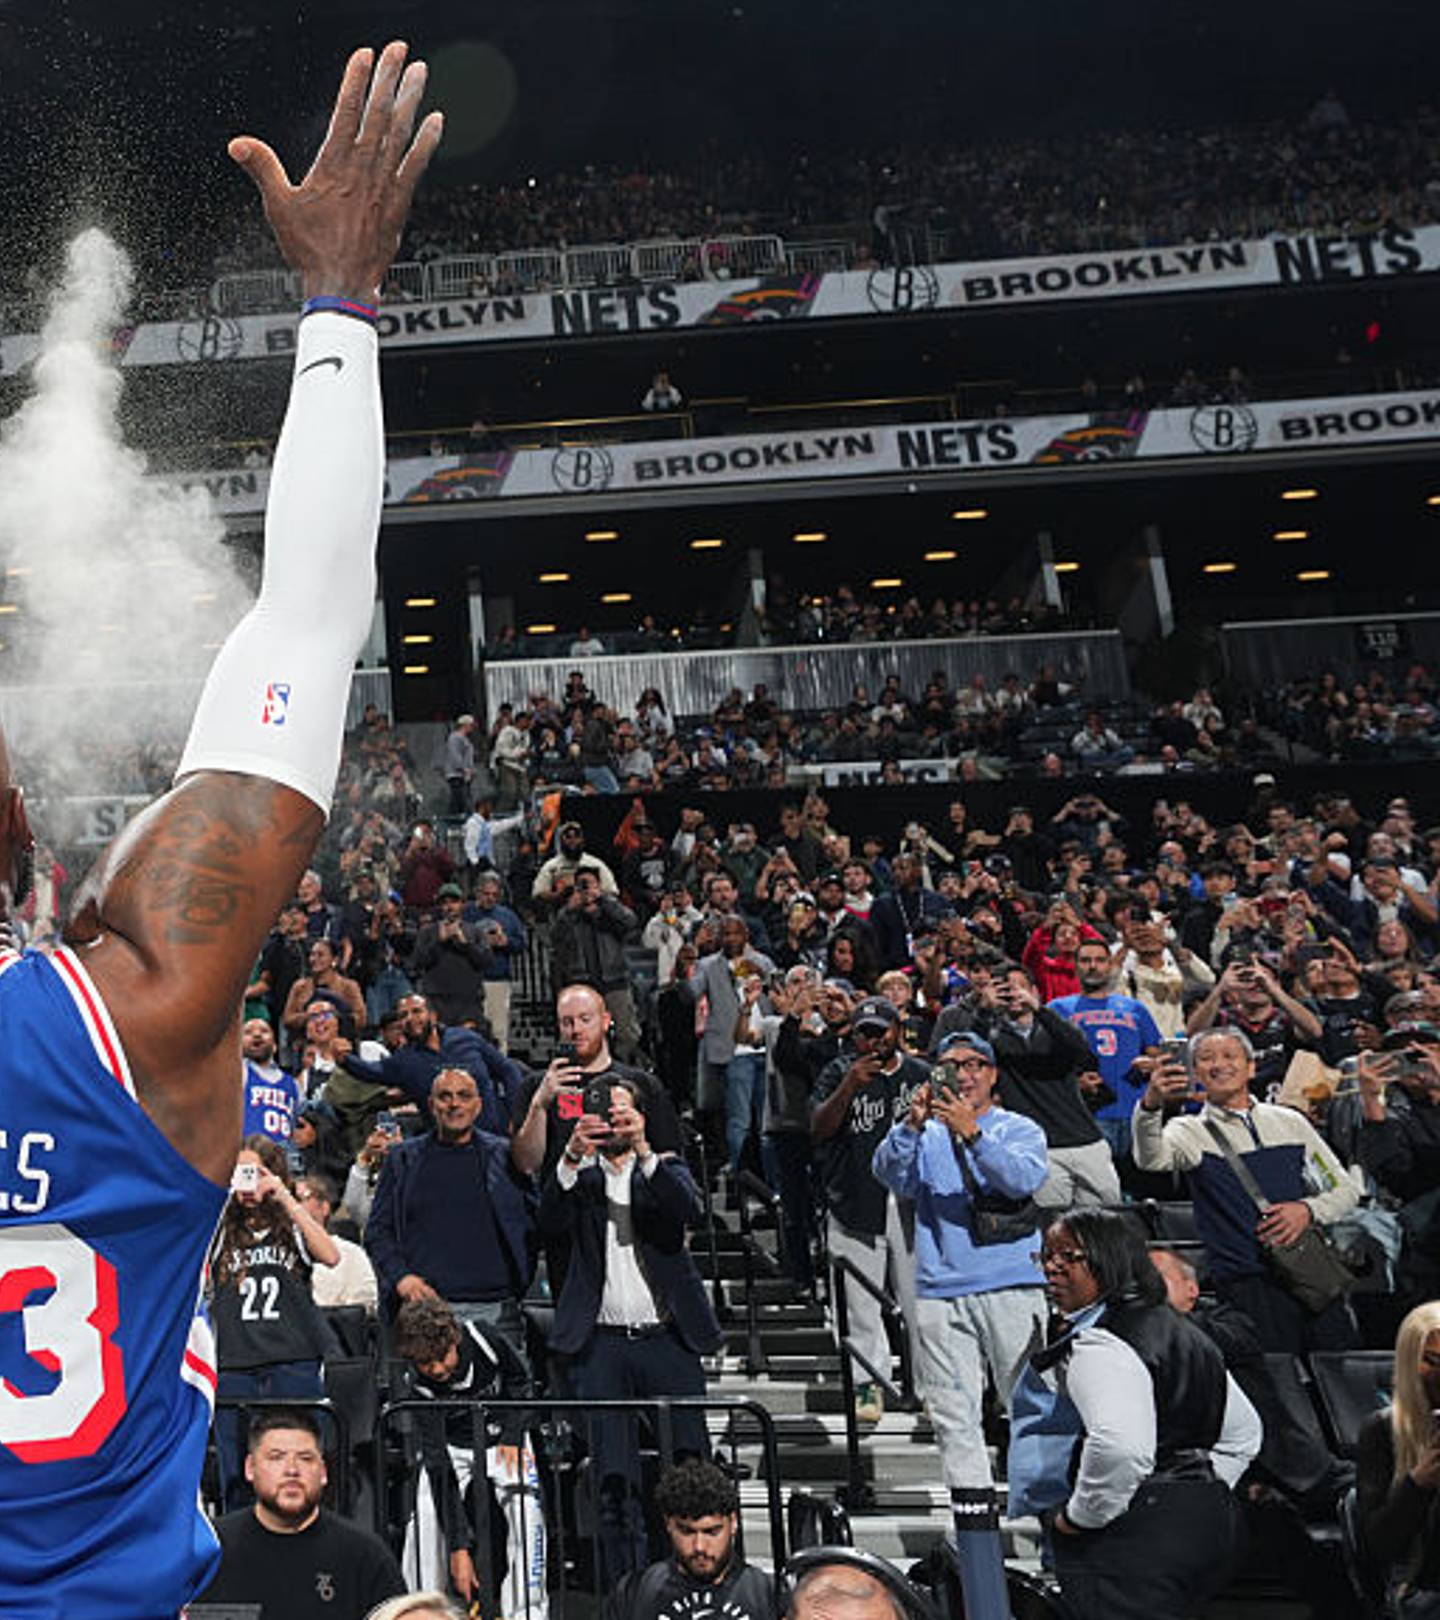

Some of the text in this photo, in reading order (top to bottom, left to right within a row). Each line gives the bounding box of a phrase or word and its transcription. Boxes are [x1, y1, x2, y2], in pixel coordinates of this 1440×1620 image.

[551, 284, 682, 336] NETS
[962, 243, 1247, 302] BROOKLYN
[1275, 229, 1422, 283] NETS
[633, 433, 876, 483] BROOKLYN
[896, 424, 1019, 470] NETS
[1096, 1029, 1118, 1056] 3
[238, 1276, 281, 1321] 22
